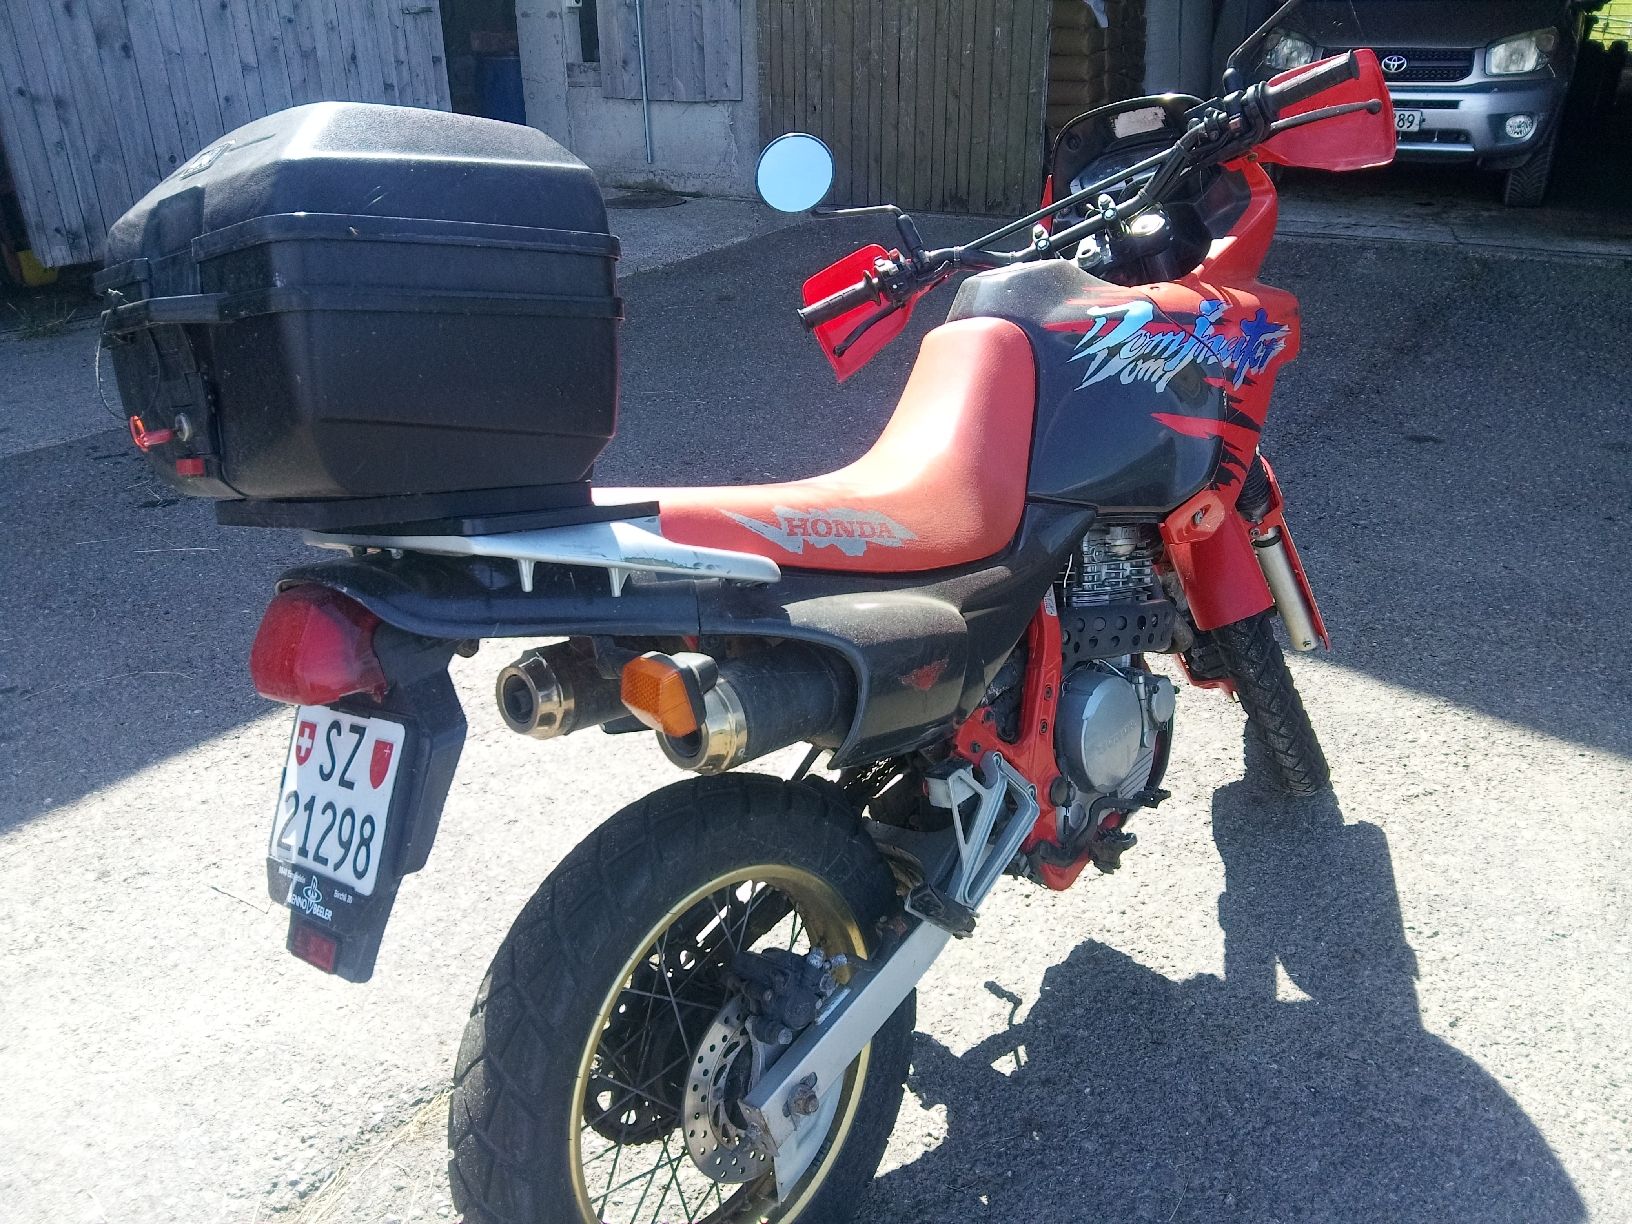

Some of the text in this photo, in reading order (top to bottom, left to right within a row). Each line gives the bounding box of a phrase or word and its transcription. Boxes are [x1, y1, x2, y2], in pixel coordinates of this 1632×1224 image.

[1394, 113, 1415, 129] 89
[785, 516, 897, 539] HONDA
[318, 720, 367, 791] SZ
[276, 790, 376, 881] 21298
